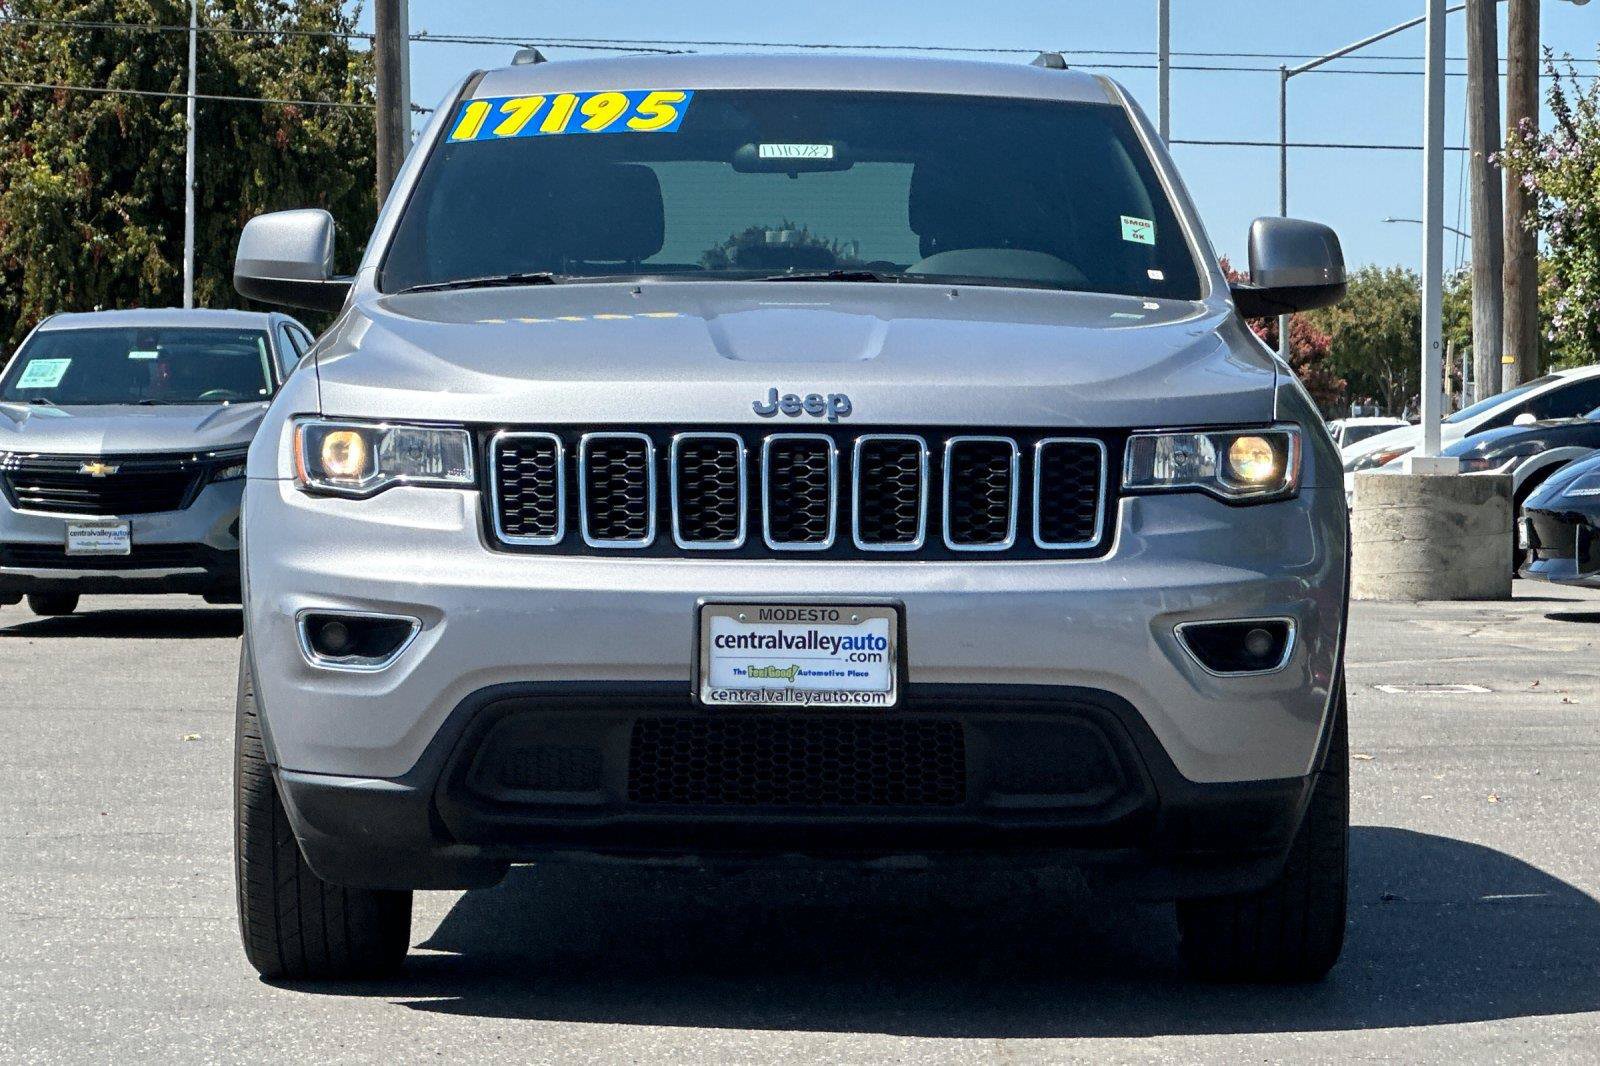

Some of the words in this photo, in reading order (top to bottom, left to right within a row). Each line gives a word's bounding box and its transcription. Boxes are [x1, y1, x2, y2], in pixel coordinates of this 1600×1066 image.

[451, 90, 687, 140] 17195
[752, 387, 852, 423] Jeep
[758, 608, 839, 622] MODESTO
[714, 630, 887, 655] centralvalleyauto
[844, 652, 882, 663] .com
[733, 668, 746, 676] The
[797, 669, 845, 677] Automotive
[847, 670, 869, 678] Place
[711, 688, 886, 705] centralvalleyauto.com
